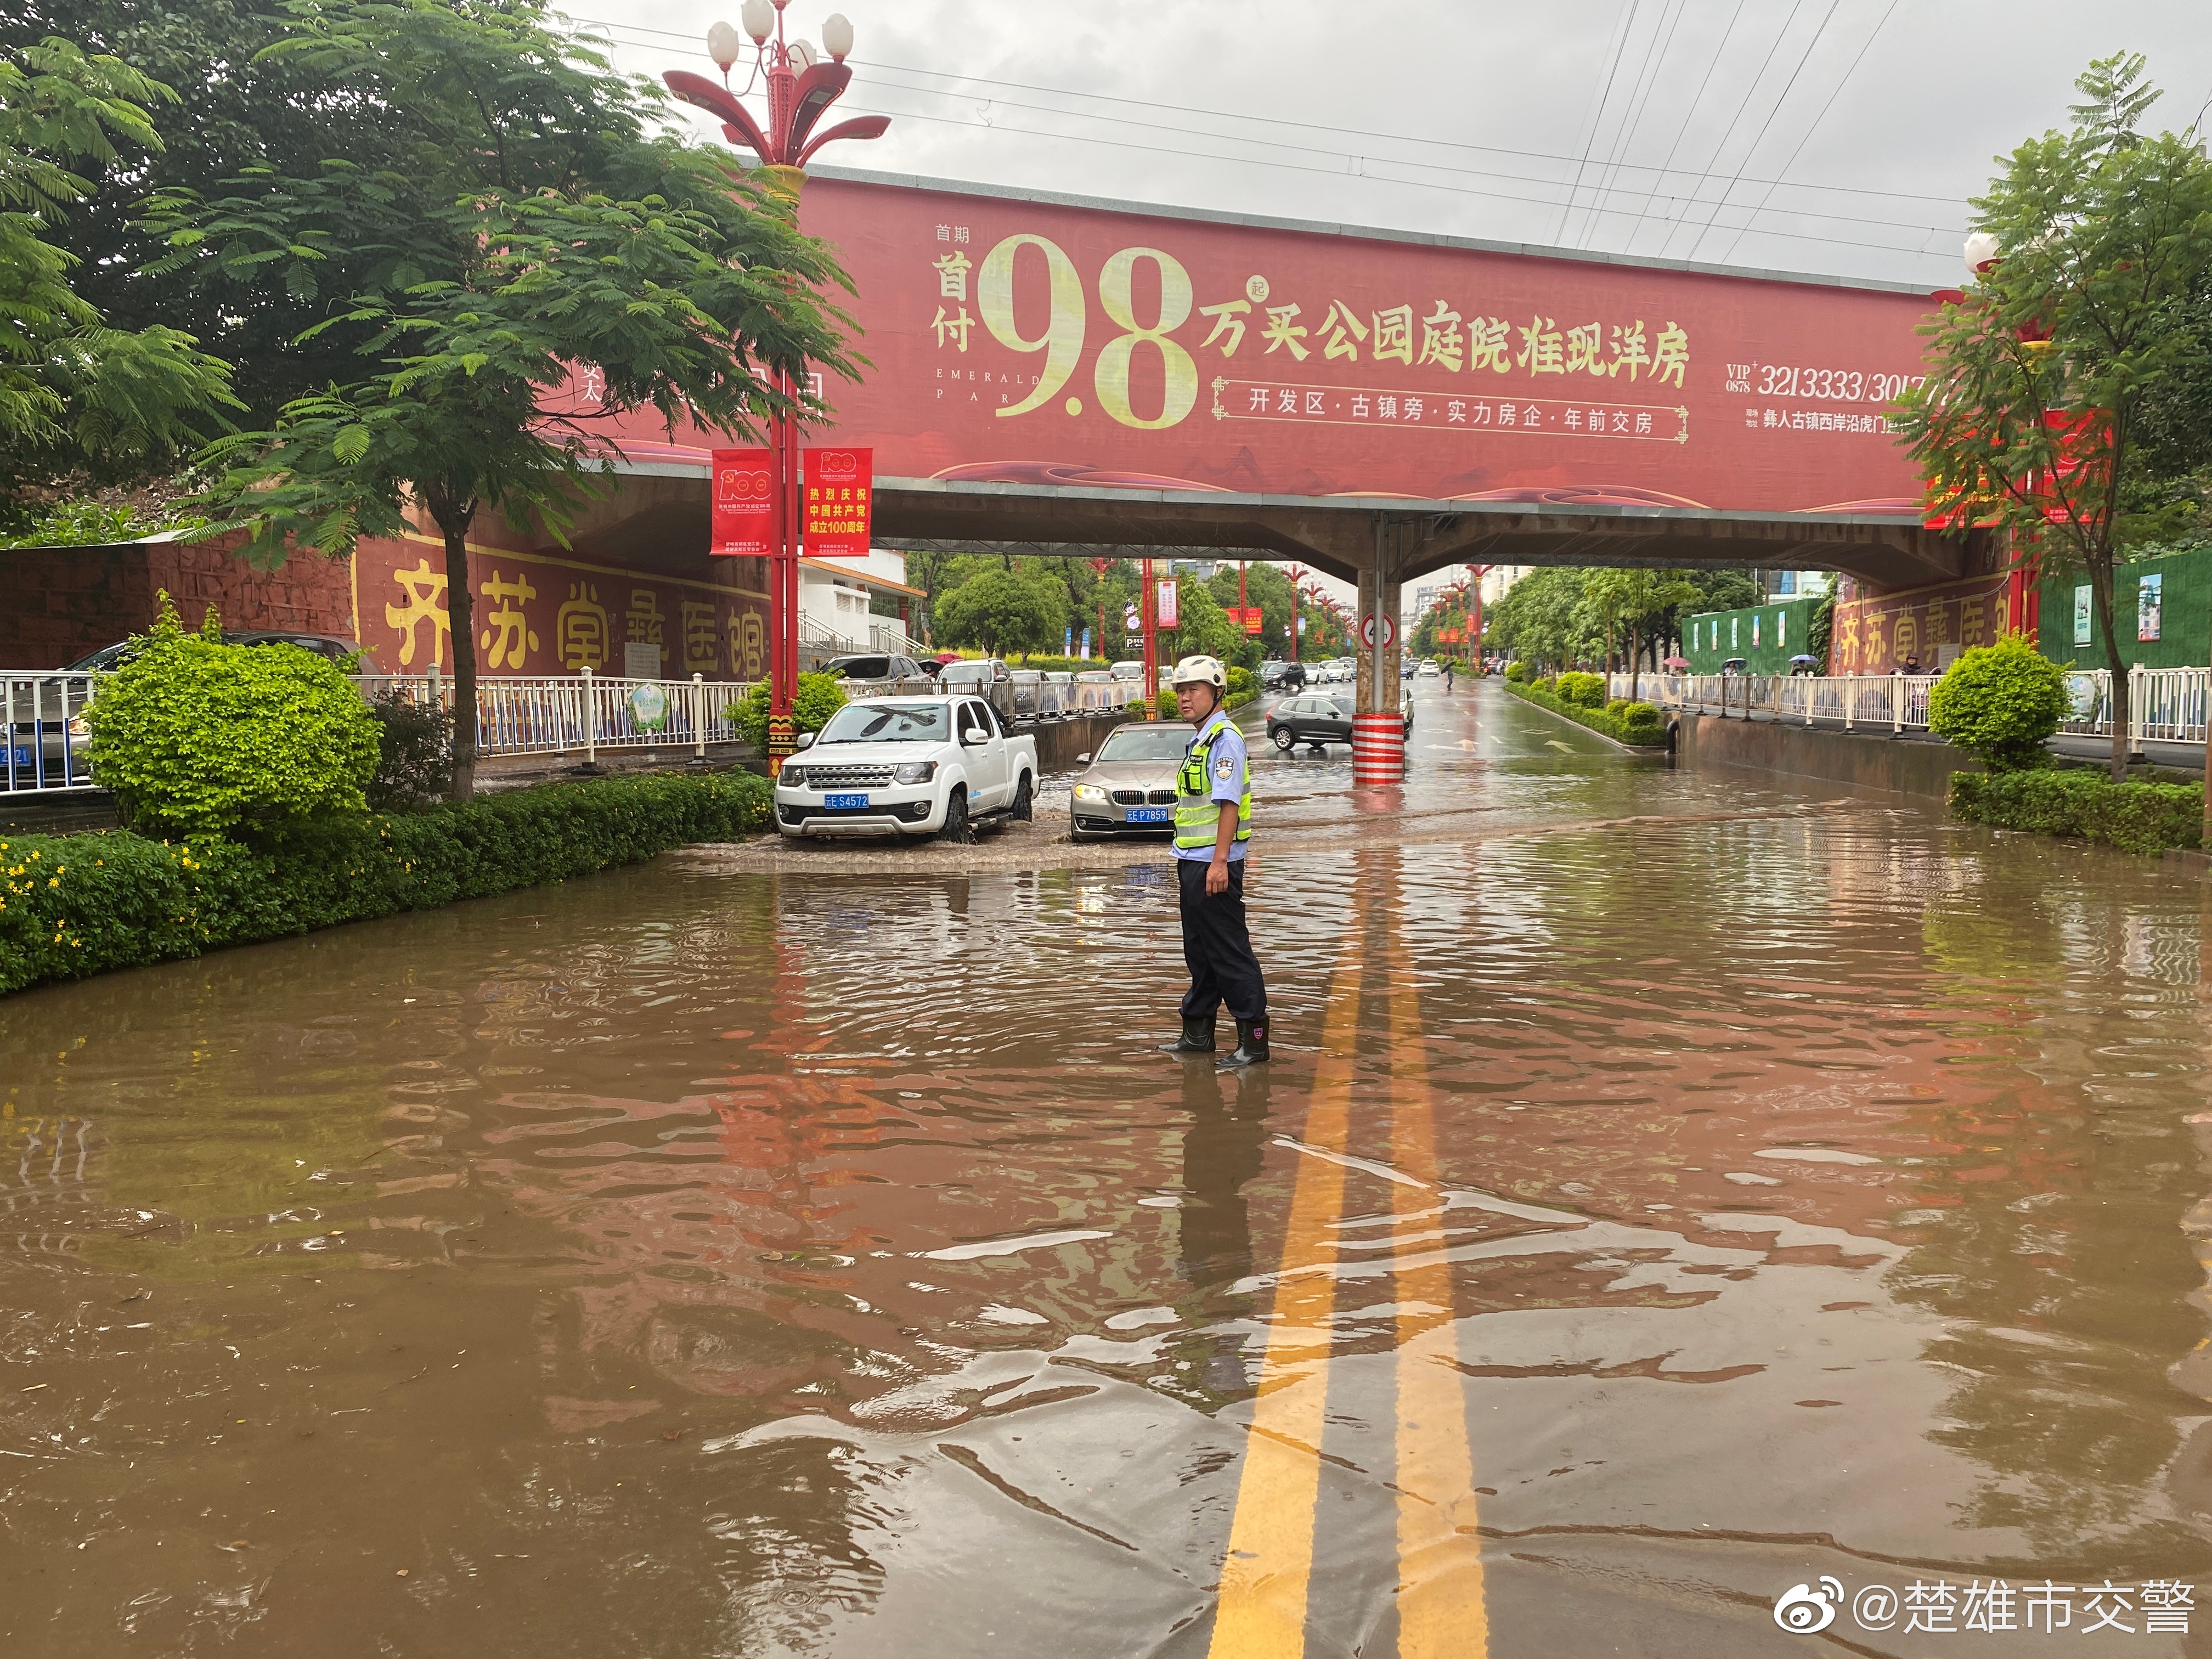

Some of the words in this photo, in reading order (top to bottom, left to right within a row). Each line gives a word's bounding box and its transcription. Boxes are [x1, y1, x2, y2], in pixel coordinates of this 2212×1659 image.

[935, 223, 969, 244] 首期
[1251, 280, 1265, 296] 起
[930, 249, 976, 352] 首付
[977, 233, 1198, 430] 9.8
[936, 368, 1039, 385] EMERALD
[1725, 380, 1751, 393] 0878
[810, 487, 866, 501] 热烈庆祝
[810, 504, 866, 517] 中国共产党
[809, 520, 865, 534] 成立100周年
[386, 558, 764, 678] 齐苏堂彝医馆
[1181, 809, 1216, 821] POLICE
